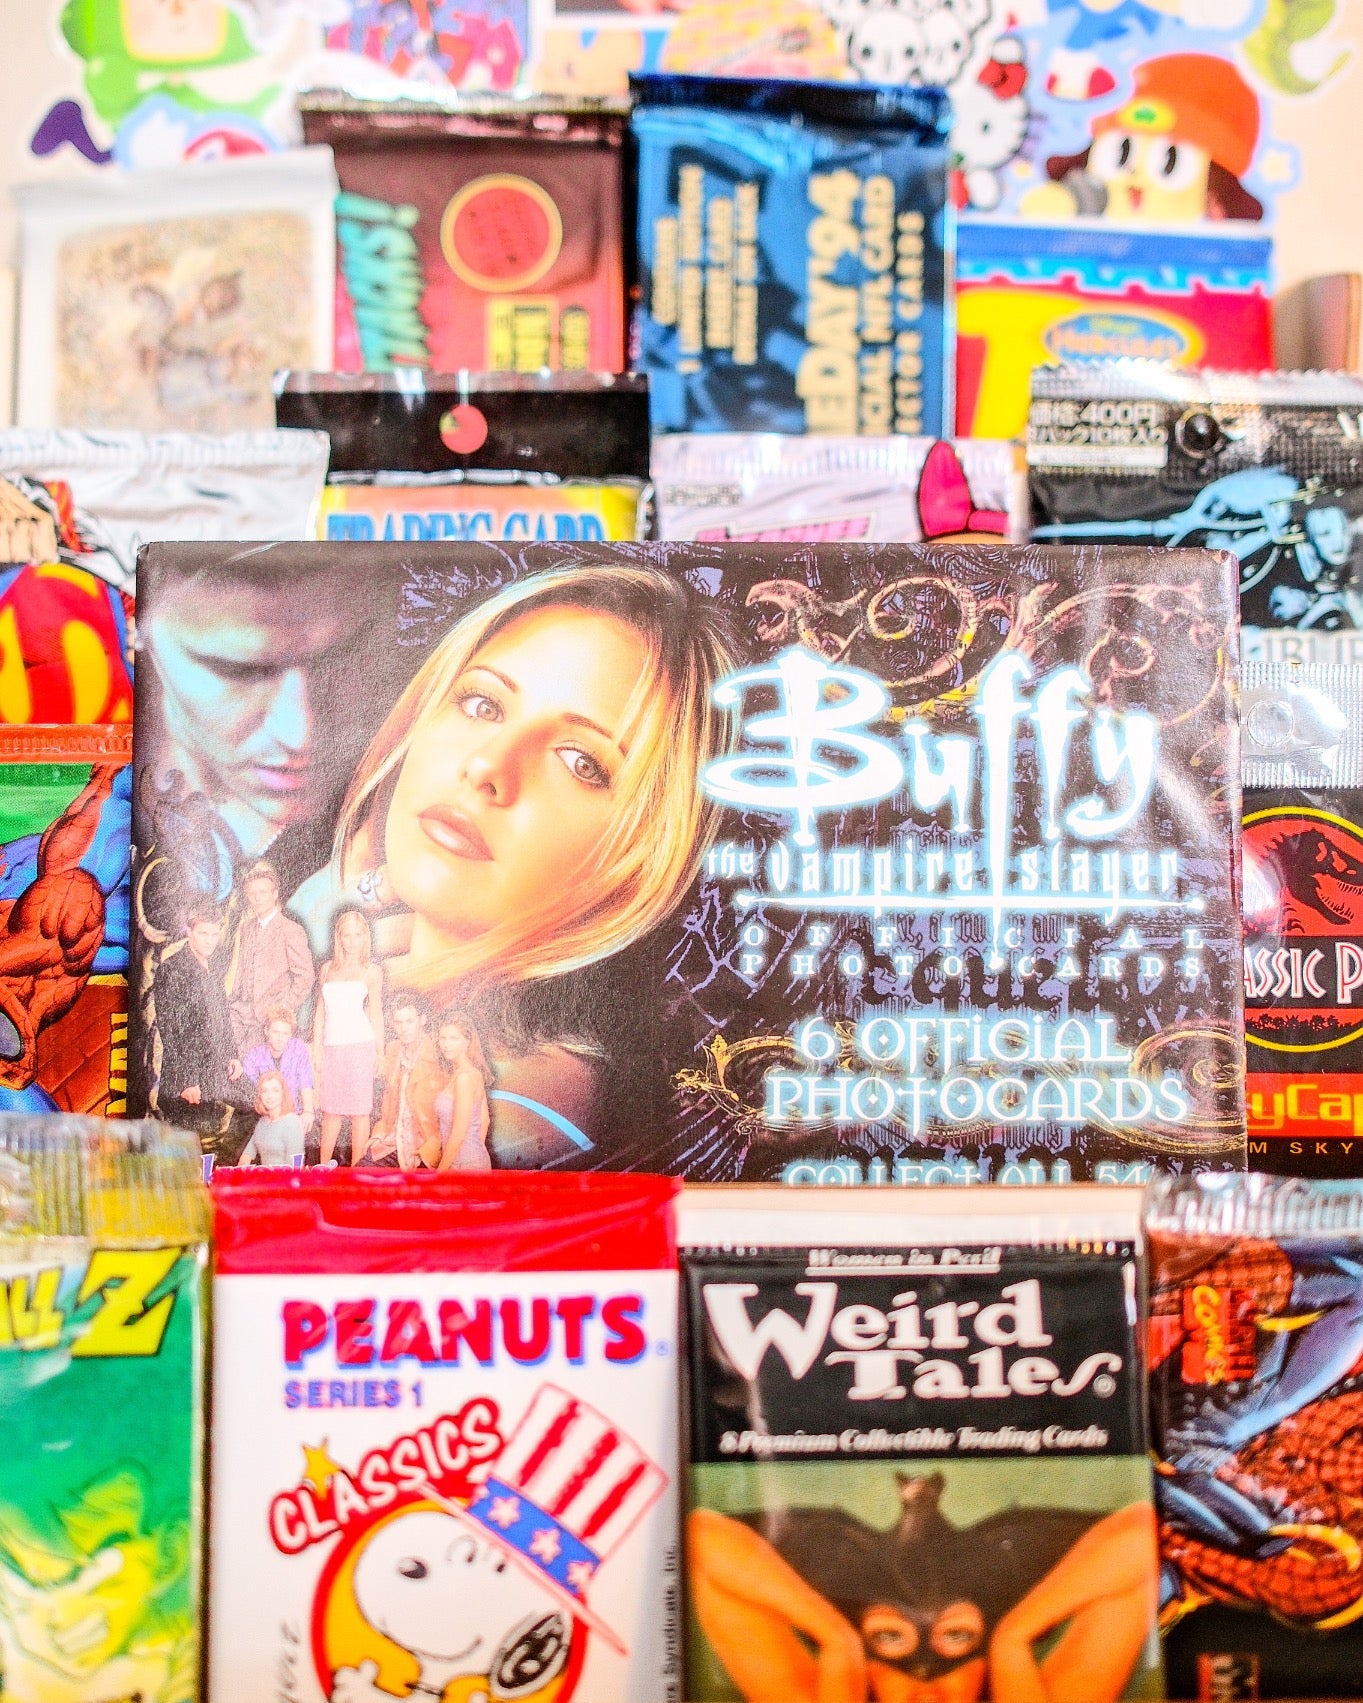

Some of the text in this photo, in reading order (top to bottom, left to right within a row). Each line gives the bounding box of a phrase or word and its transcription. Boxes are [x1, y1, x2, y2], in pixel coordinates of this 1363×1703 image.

[699, 650, 1160, 852] Buffy
[706, 846, 754, 879] the
[743, 926, 1204, 949] OFFICIAL
[799, 1015, 837, 1062] 6
[766, 1076, 1189, 1136] PHOTOCARDS
[808, 1248, 904, 1267] Women
[907, 1248, 936, 1266] in
[70, 1246, 184, 1359] Z
[702, 1278, 1054, 1381] Weird
[280, 1295, 649, 1370] PEANUTS
[285, 1379, 424, 1408] SERIES 1
[823, 1345, 1123, 1401] Tales
[738, 1430, 838, 1453] Premium
[839, 1427, 955, 1453] Collectible
[956, 1426, 1040, 1454] Trading
[1041, 1424, 1108, 1449] Cards
[270, 1400, 505, 1552] CLASSICS
